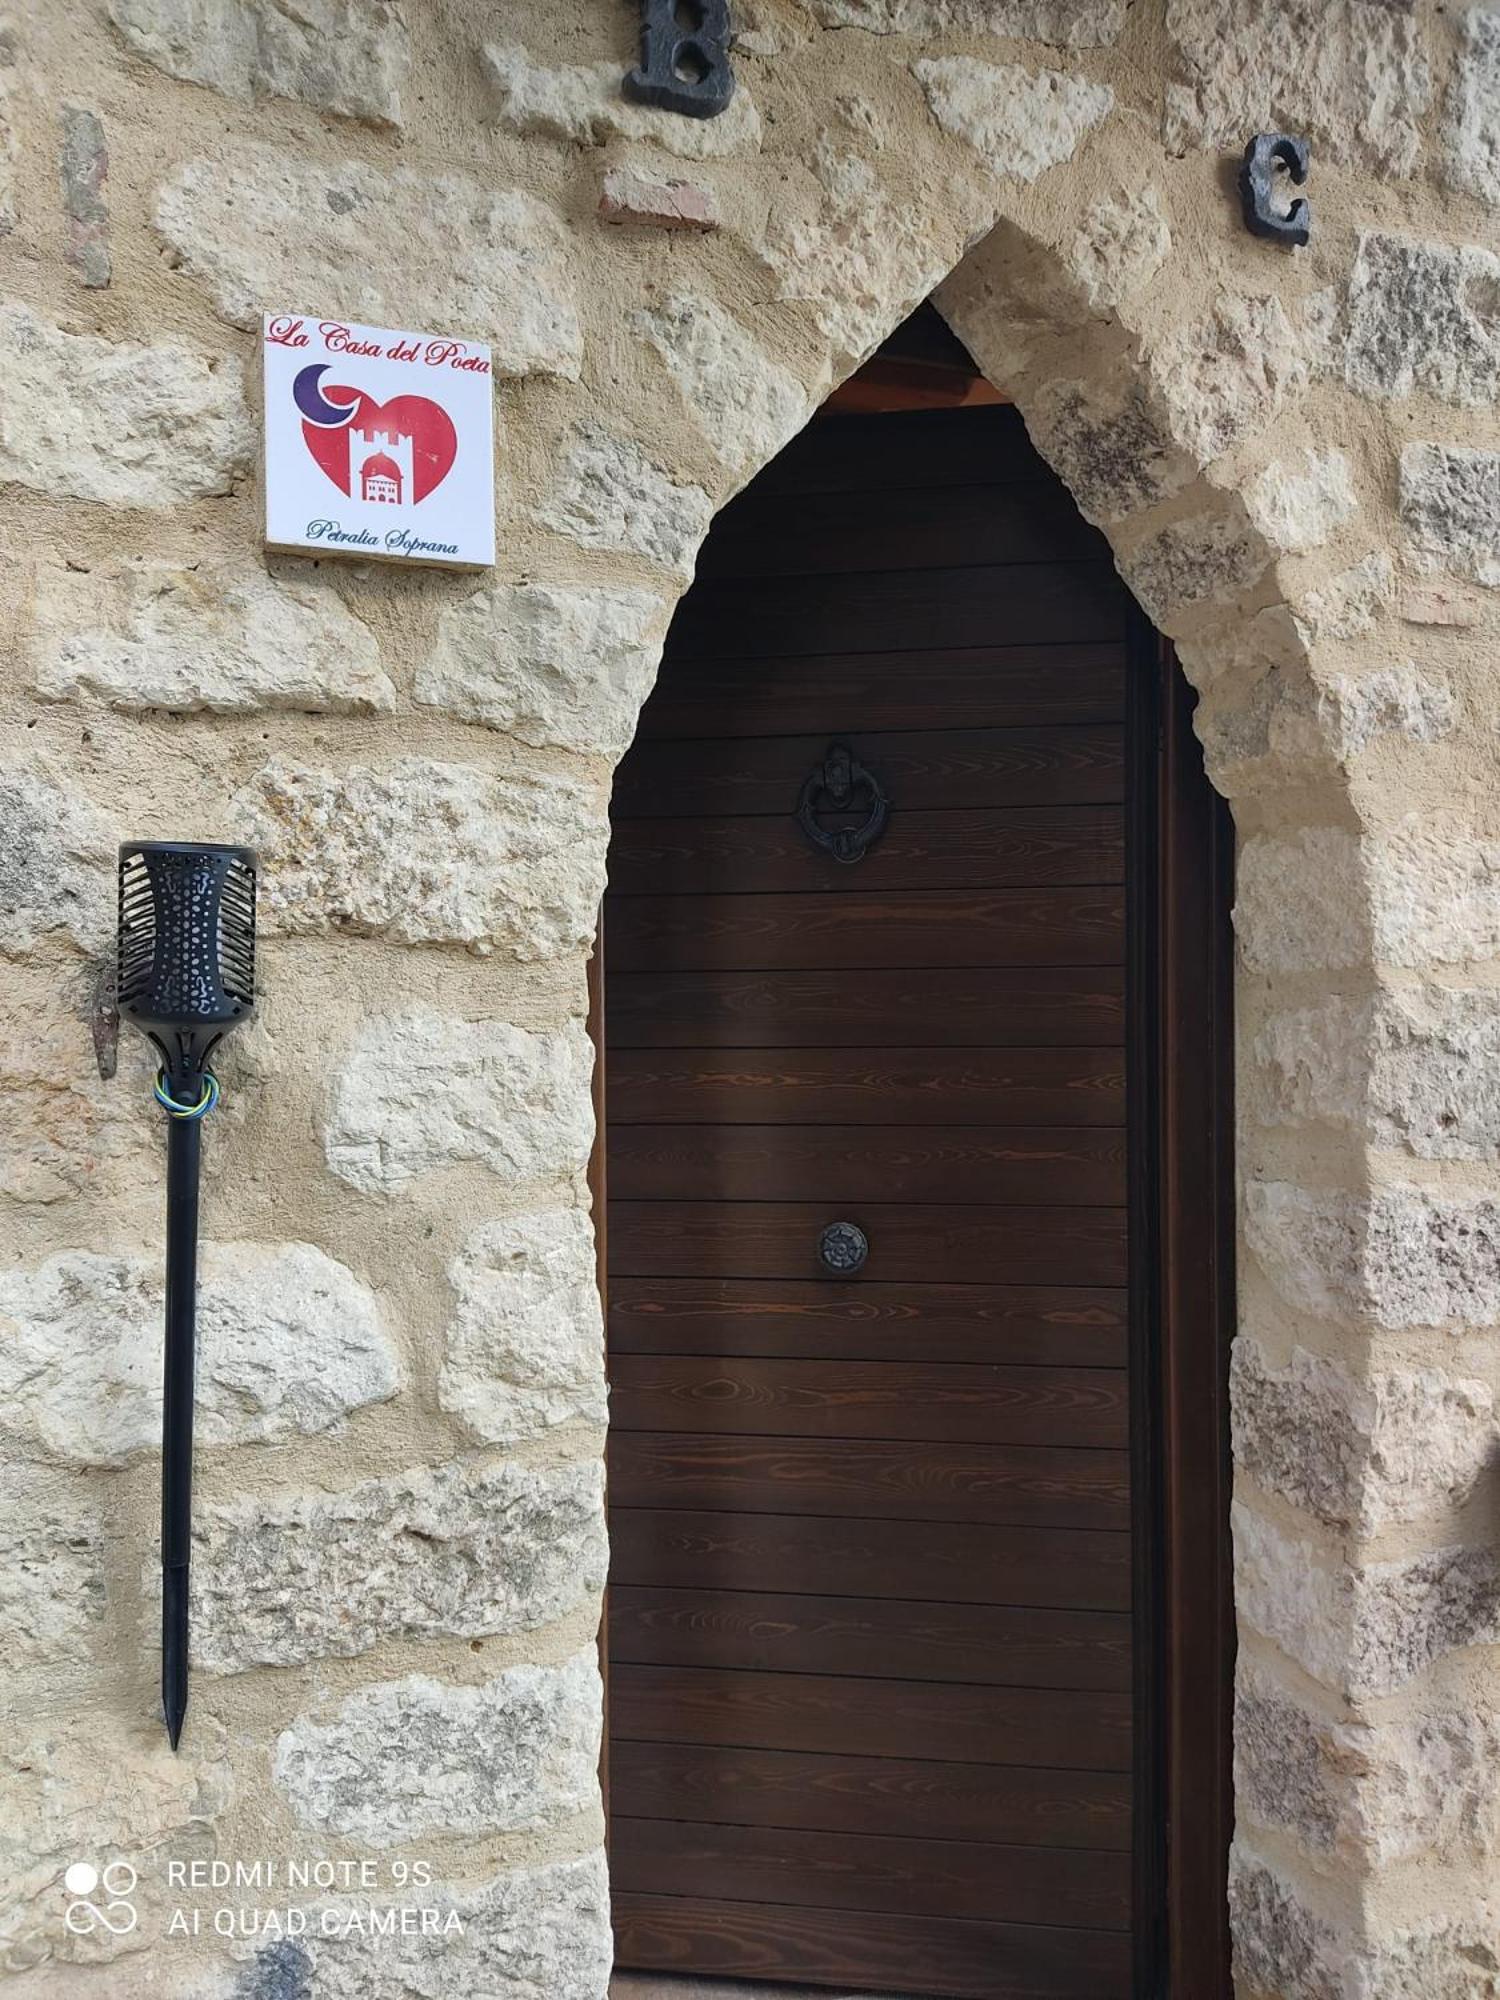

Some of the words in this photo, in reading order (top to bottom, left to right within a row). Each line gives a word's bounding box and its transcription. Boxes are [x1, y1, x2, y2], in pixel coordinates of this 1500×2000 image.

[265, 316, 310, 347] La
[319, 322, 383, 358] Casa
[387, 340, 419, 362] del
[424, 340, 490, 374] Poeta
[305, 519, 379, 546] Petralia
[384, 528, 459, 556] Soprana
